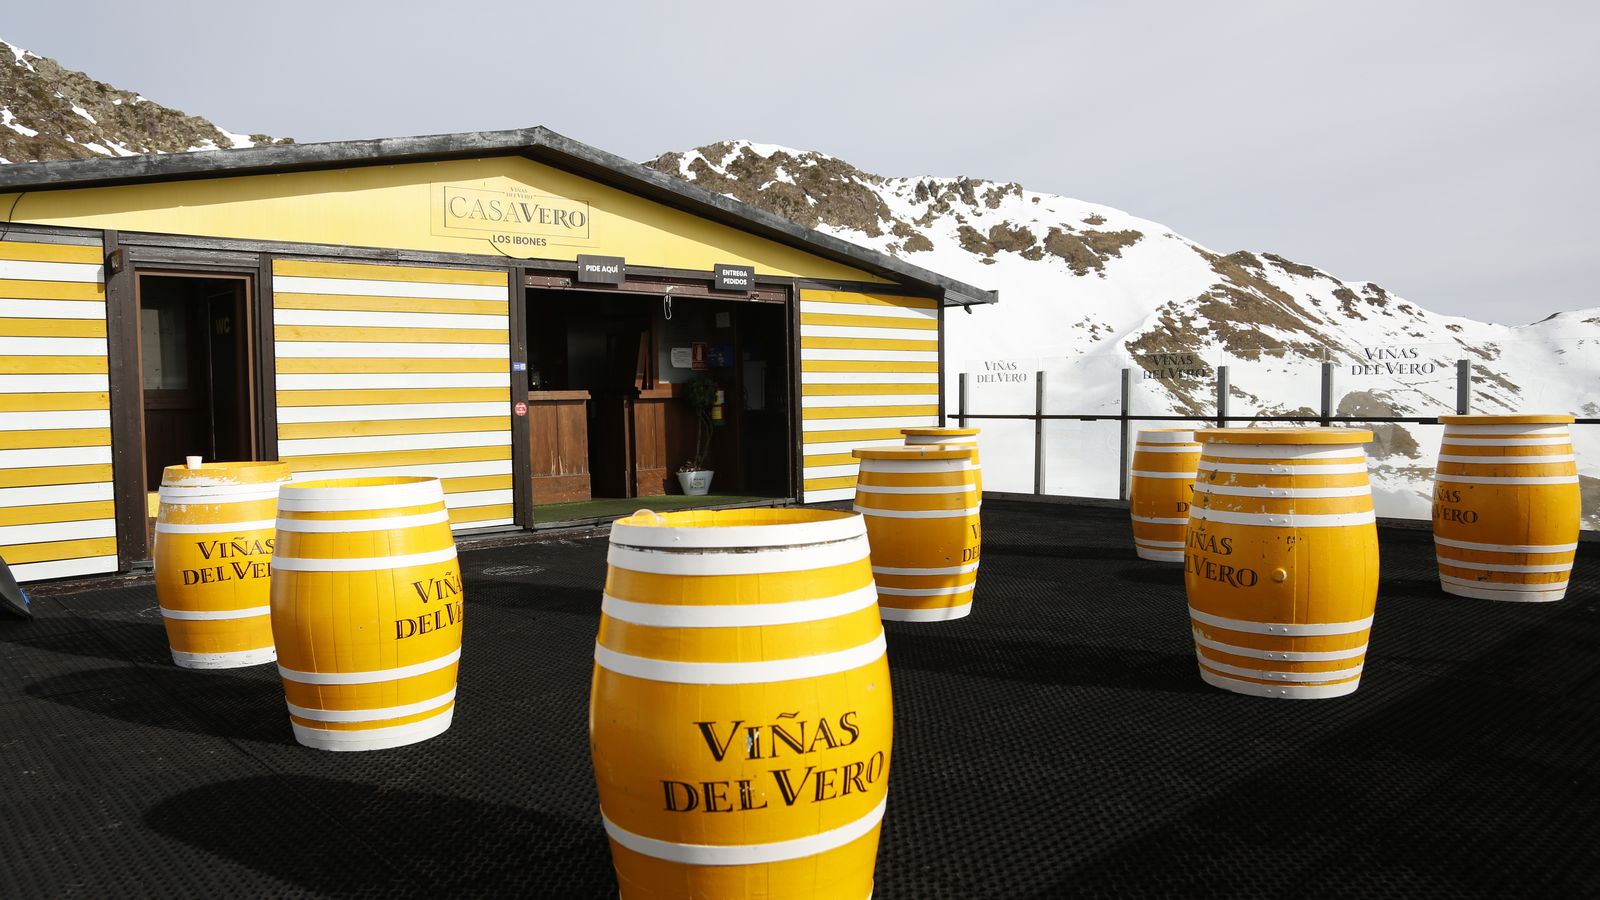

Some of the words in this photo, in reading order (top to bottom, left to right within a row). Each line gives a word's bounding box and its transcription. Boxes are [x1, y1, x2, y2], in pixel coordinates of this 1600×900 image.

[492, 234, 511, 244] LOS
[512, 235, 547, 247] IBONES
[585, 264, 601, 272] PIDE
[601, 264, 619, 274] AQUÍ
[722, 269, 748, 278] ENTREGA
[723, 278, 748, 286] PEDIDOS
[215, 316, 231, 335] WC
[1364, 345, 1419, 360] VIÑAS
[984, 359, 1017, 371] VIÑAS
[196, 536, 275, 560] VIÑAS
[692, 710, 860, 762] VIÑAS
